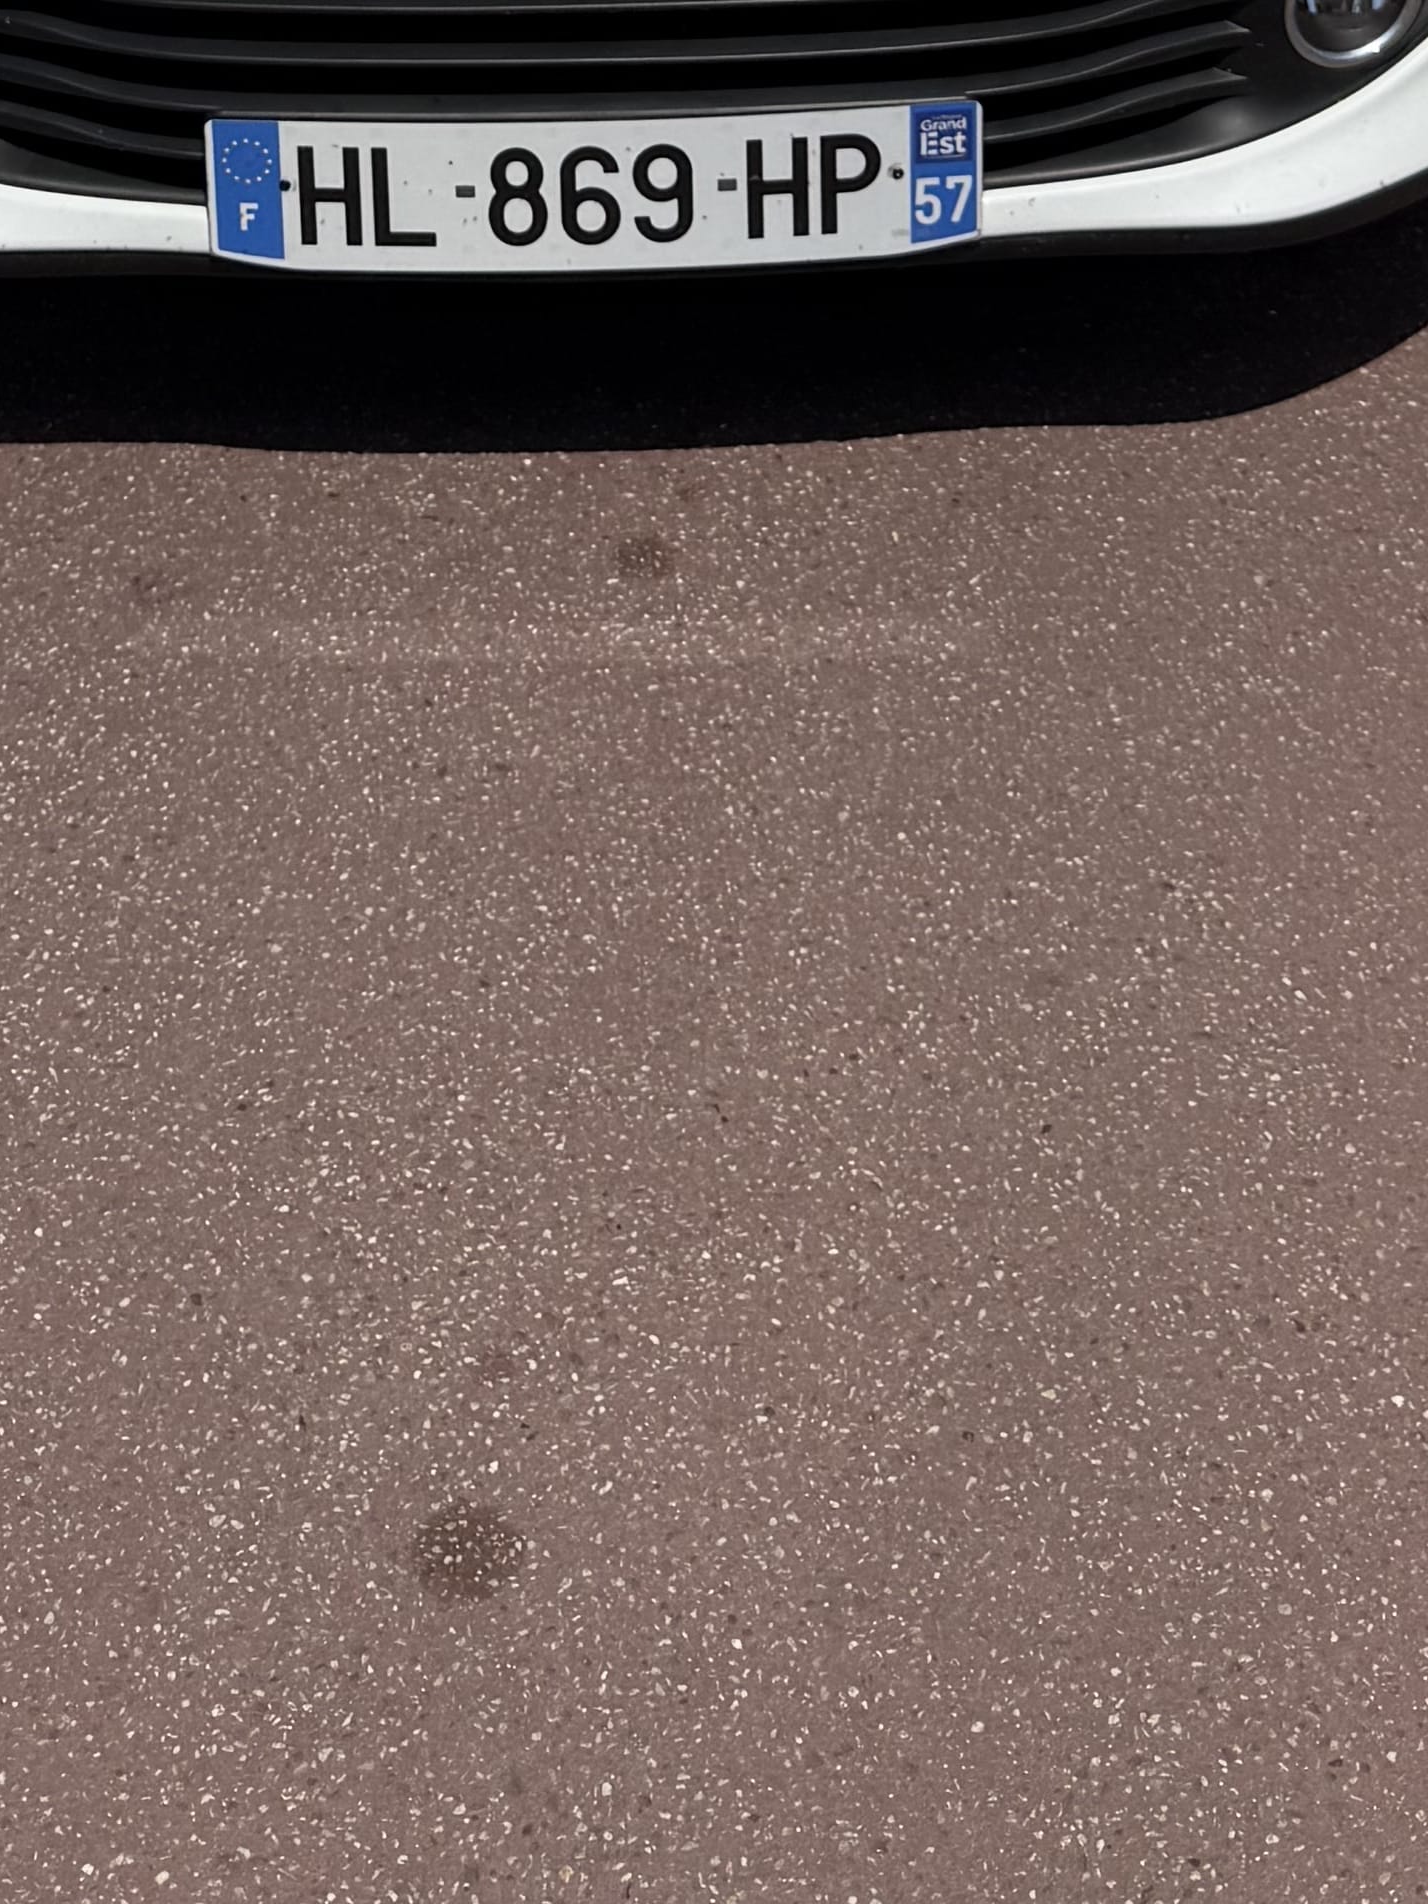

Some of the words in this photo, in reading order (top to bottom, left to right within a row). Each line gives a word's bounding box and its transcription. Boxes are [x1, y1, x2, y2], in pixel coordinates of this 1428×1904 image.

[920, 116, 968, 131] Grand
[919, 131, 967, 156] Est
[914, 174, 973, 225] 57
[239, 202, 259, 232] F
